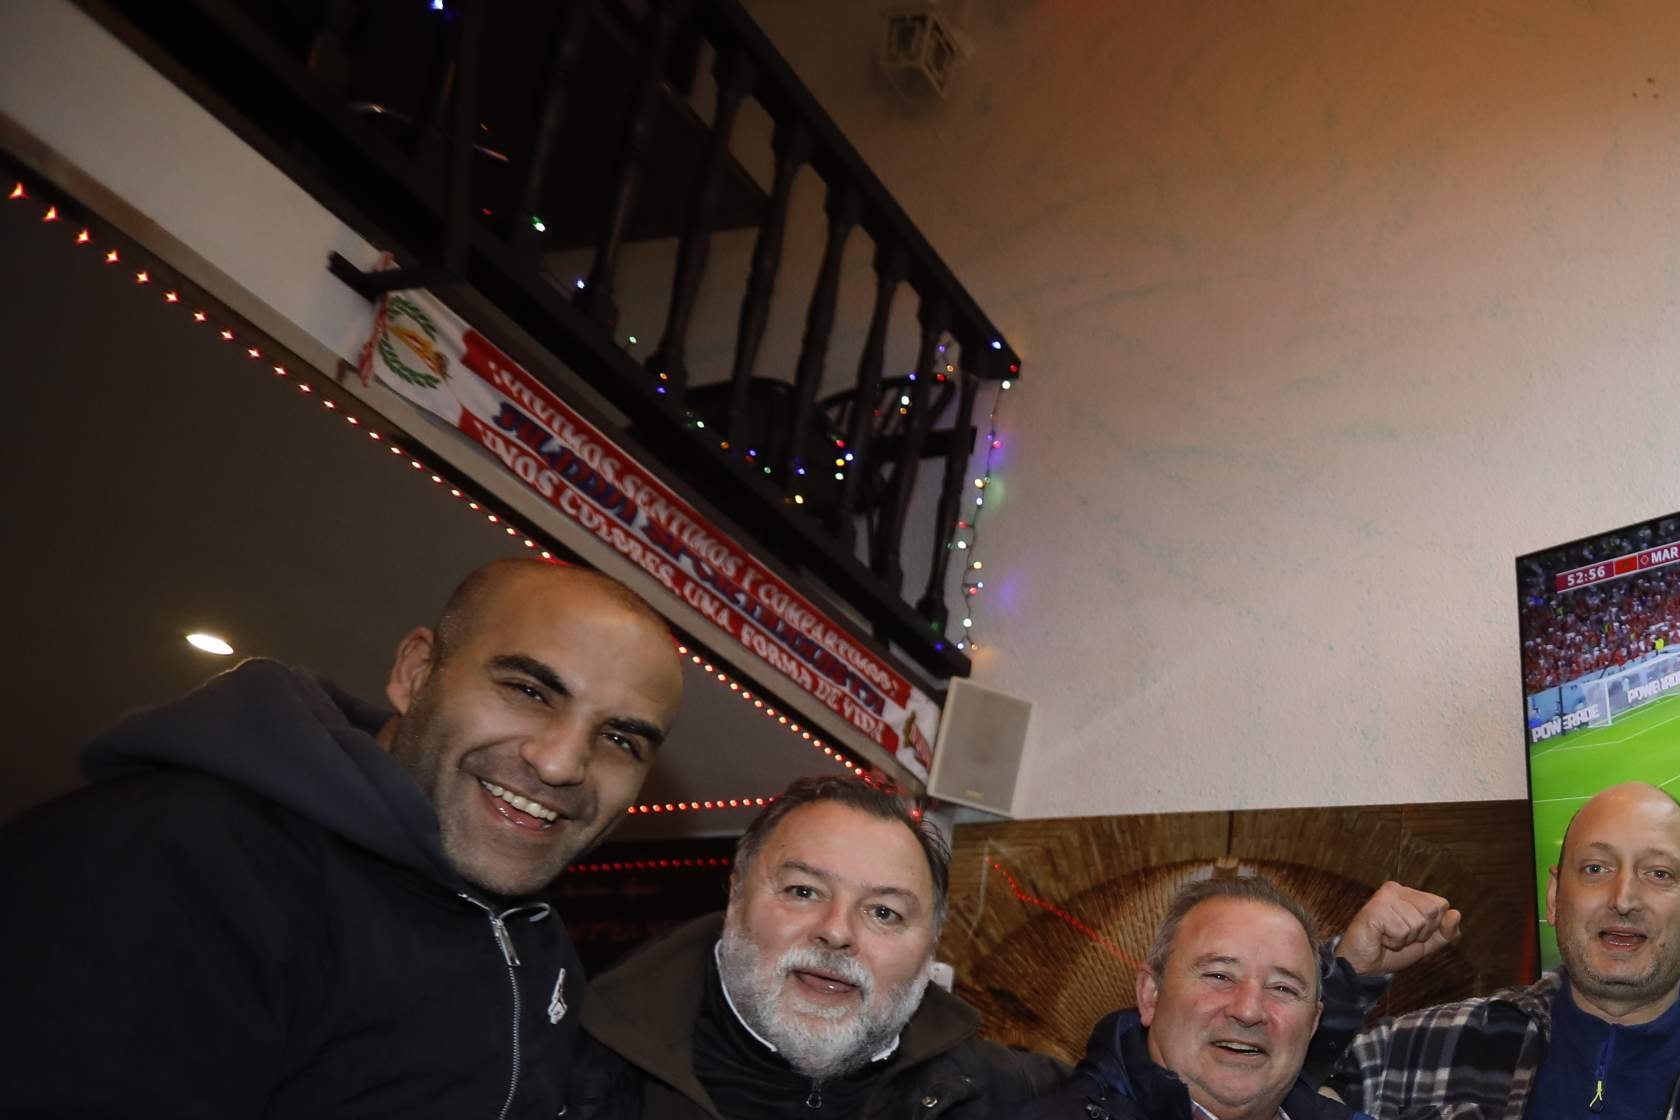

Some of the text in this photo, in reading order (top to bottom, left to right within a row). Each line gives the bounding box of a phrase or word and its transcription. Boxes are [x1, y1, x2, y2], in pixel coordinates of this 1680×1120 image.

[1567, 566, 1606, 586] 52:56
[1651, 546, 1679, 564] MAR
[741, 622, 813, 694] FORMA
[814, 677, 843, 712] DE
[843, 695, 884, 746] VIDA
[1531, 704, 1600, 743] POWERADE
